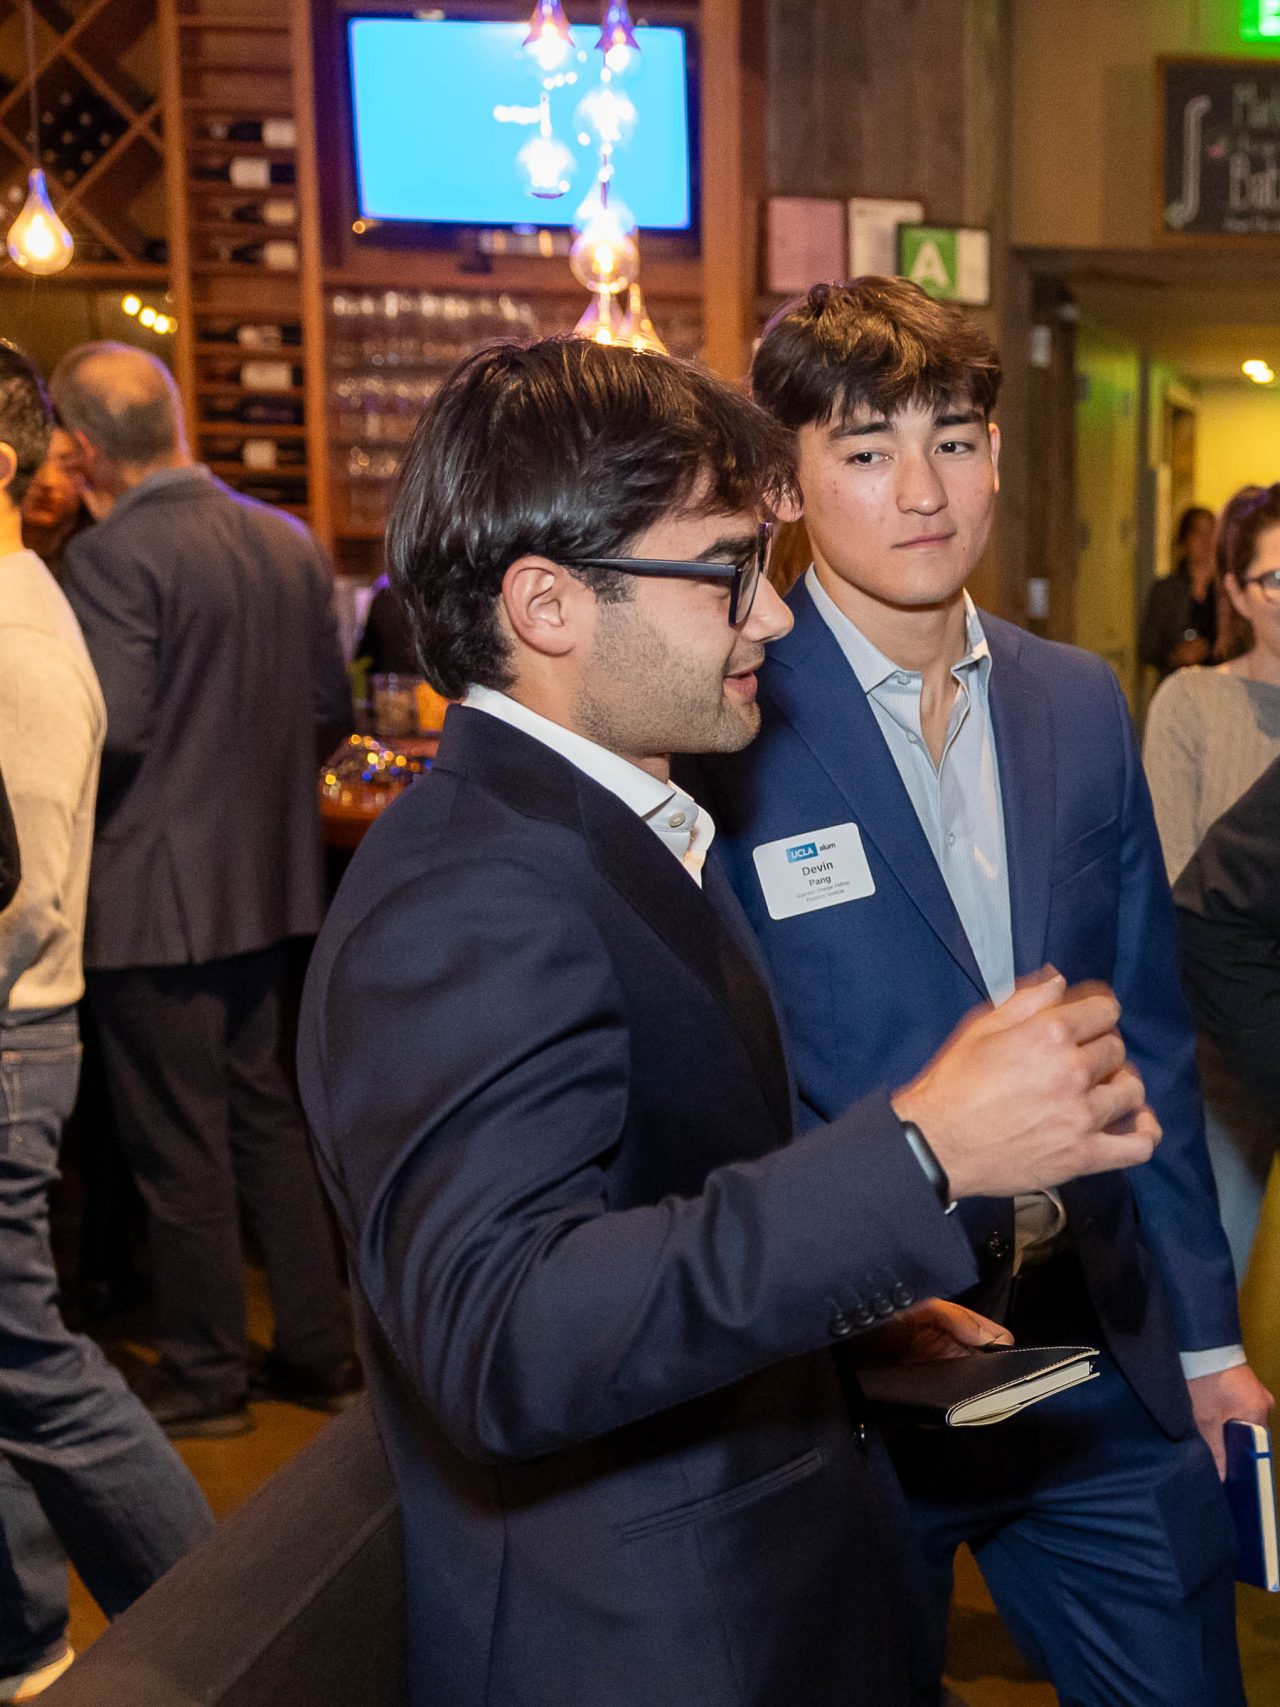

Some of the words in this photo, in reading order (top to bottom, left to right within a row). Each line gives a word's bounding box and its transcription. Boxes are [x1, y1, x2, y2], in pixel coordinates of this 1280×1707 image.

[909, 240, 951, 289] A
[790, 847, 815, 860] UCLA
[819, 841, 837, 852] alum
[801, 861, 834, 877] Devin
[808, 875, 832, 888] Pang
